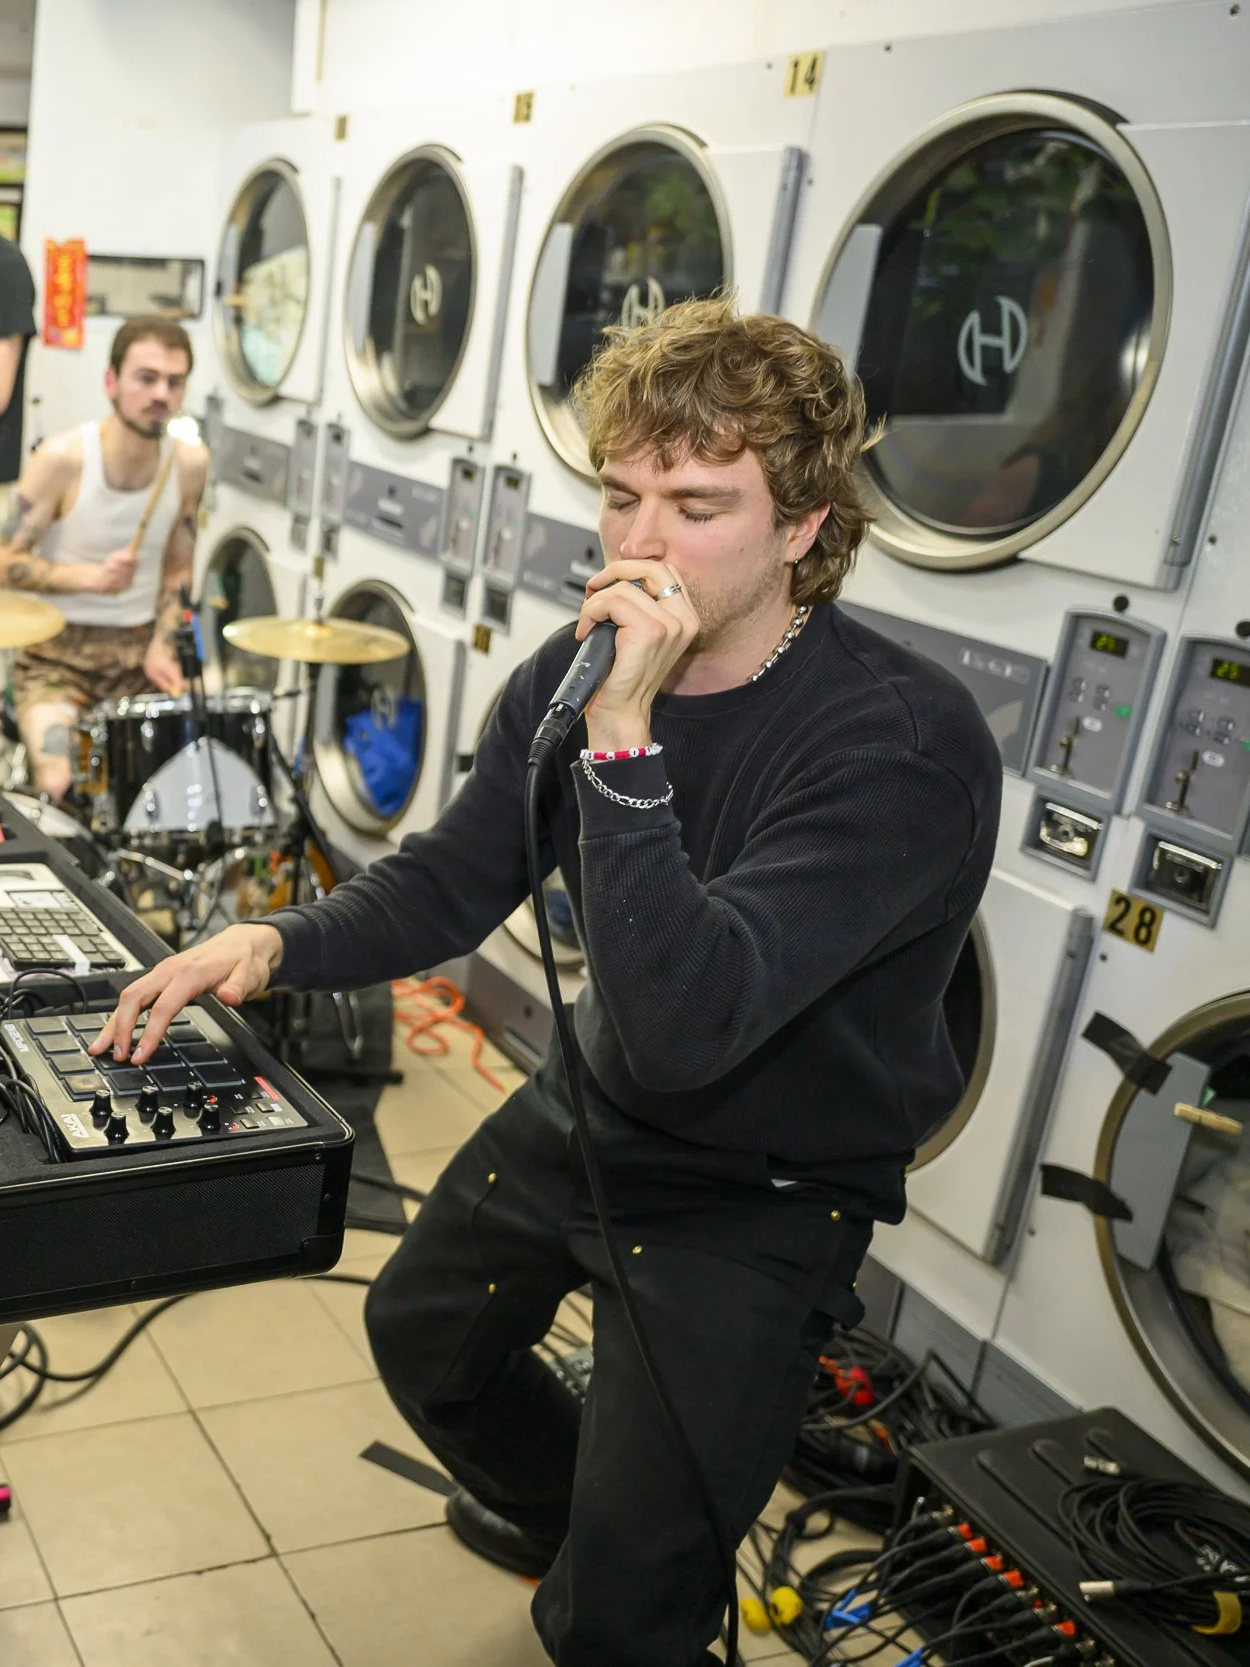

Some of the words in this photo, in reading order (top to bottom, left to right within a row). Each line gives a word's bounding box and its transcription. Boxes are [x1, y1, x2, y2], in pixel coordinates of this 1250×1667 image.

[790, 56, 818, 94] 14
[1108, 895, 1157, 945] 28
[61, 1113, 85, 1138] AKAI
